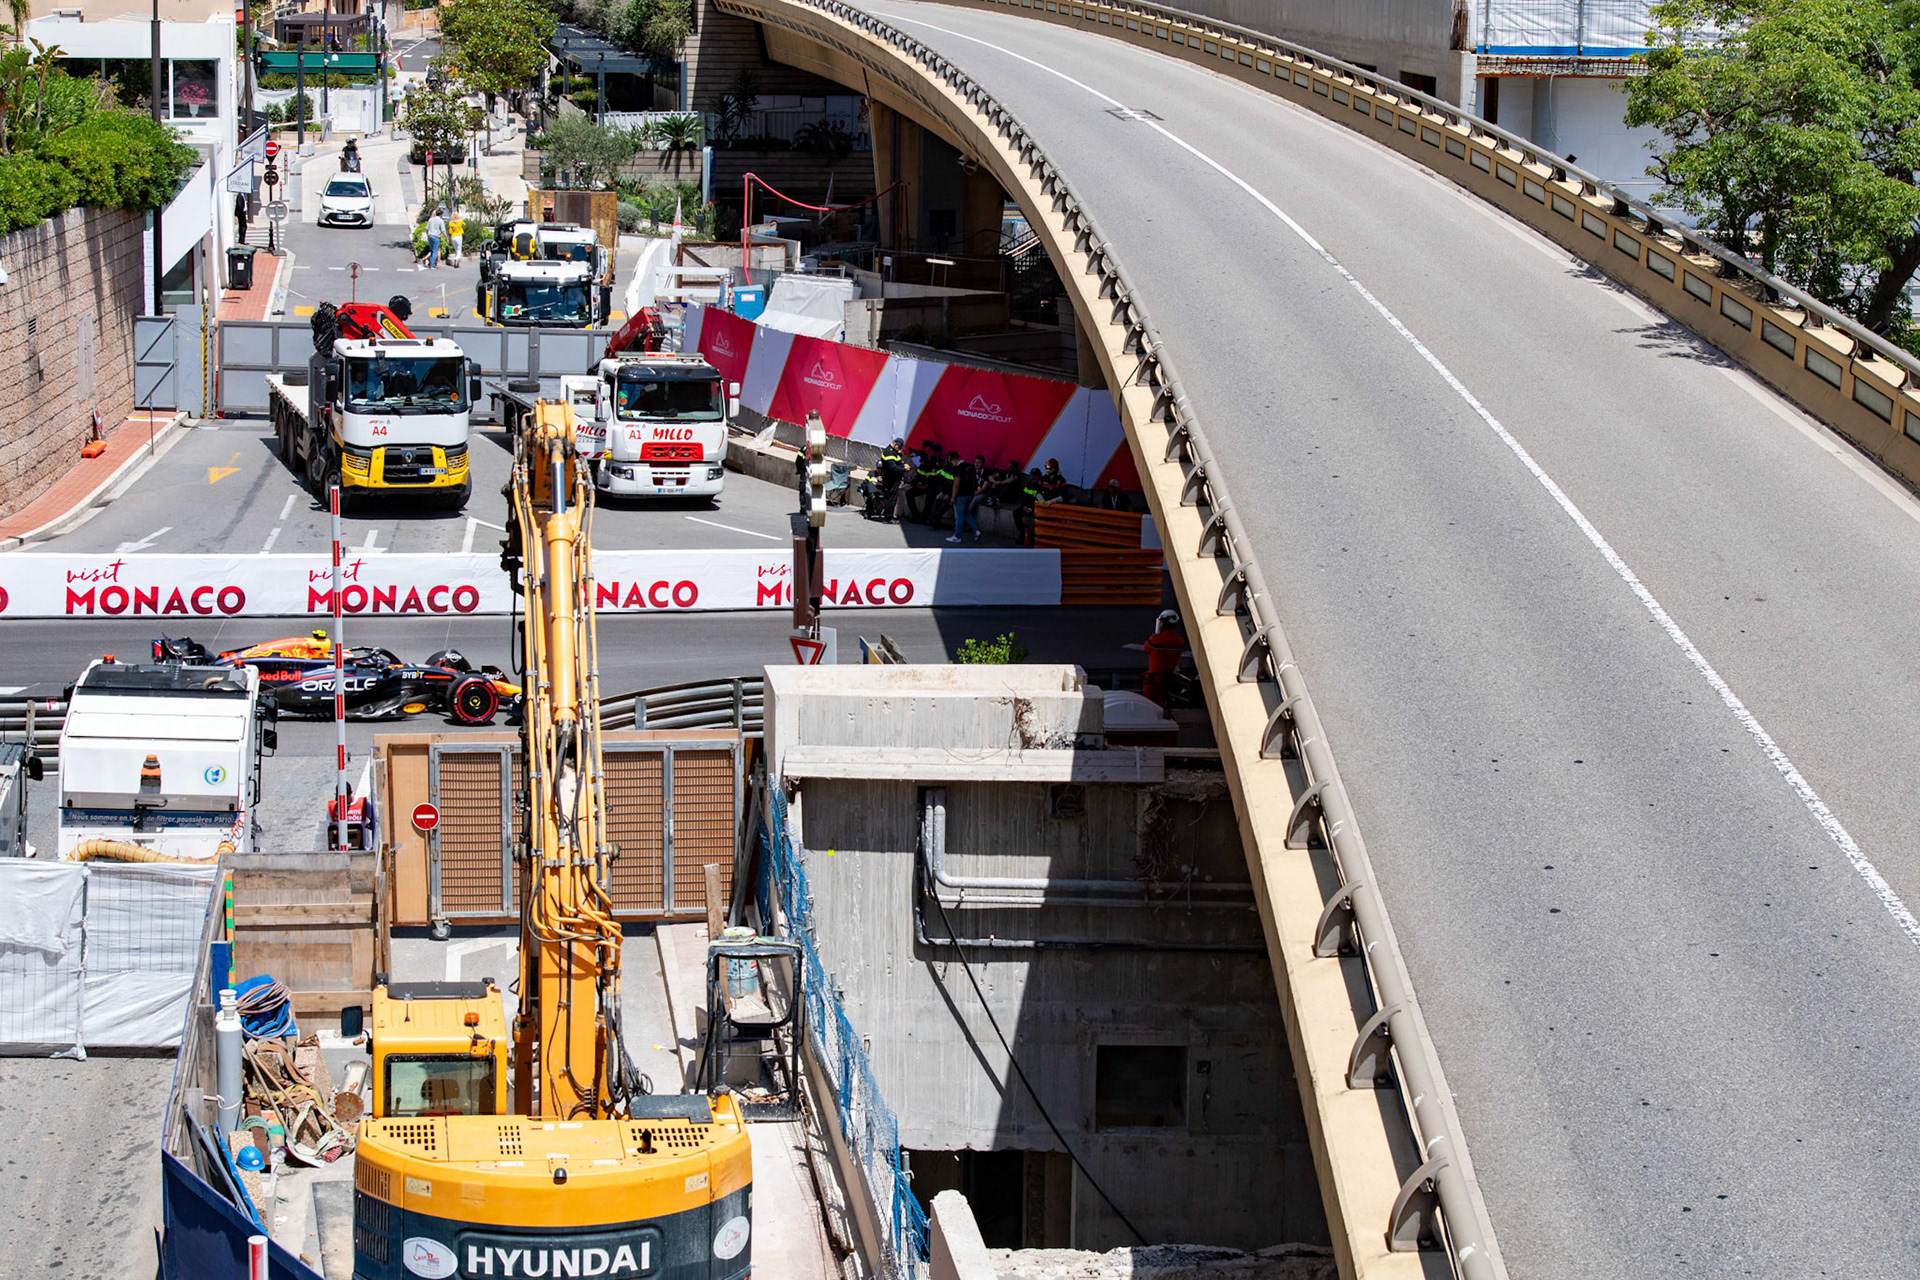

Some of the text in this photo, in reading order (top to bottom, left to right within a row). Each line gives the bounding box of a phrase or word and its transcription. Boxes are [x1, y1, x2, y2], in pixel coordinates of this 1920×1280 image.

[372, 426, 387, 436] A4
[576, 424, 607, 437] MILLO
[629, 430, 642, 440] A1
[652, 428, 693, 440] MILLO
[66, 558, 127, 583] visit
[308, 558, 367, 582] viit
[758, 562, 791, 578] vis
[65, 585, 246, 615] MONACO
[307, 584, 480, 613] MONACO
[583, 580, 698, 608] NACO
[756, 577, 914, 606] MNACO
[259, 670, 302, 681] Red Bull
[402, 670, 424, 679] BYBIT
[467, 1241, 651, 1278] HYUNDAI
